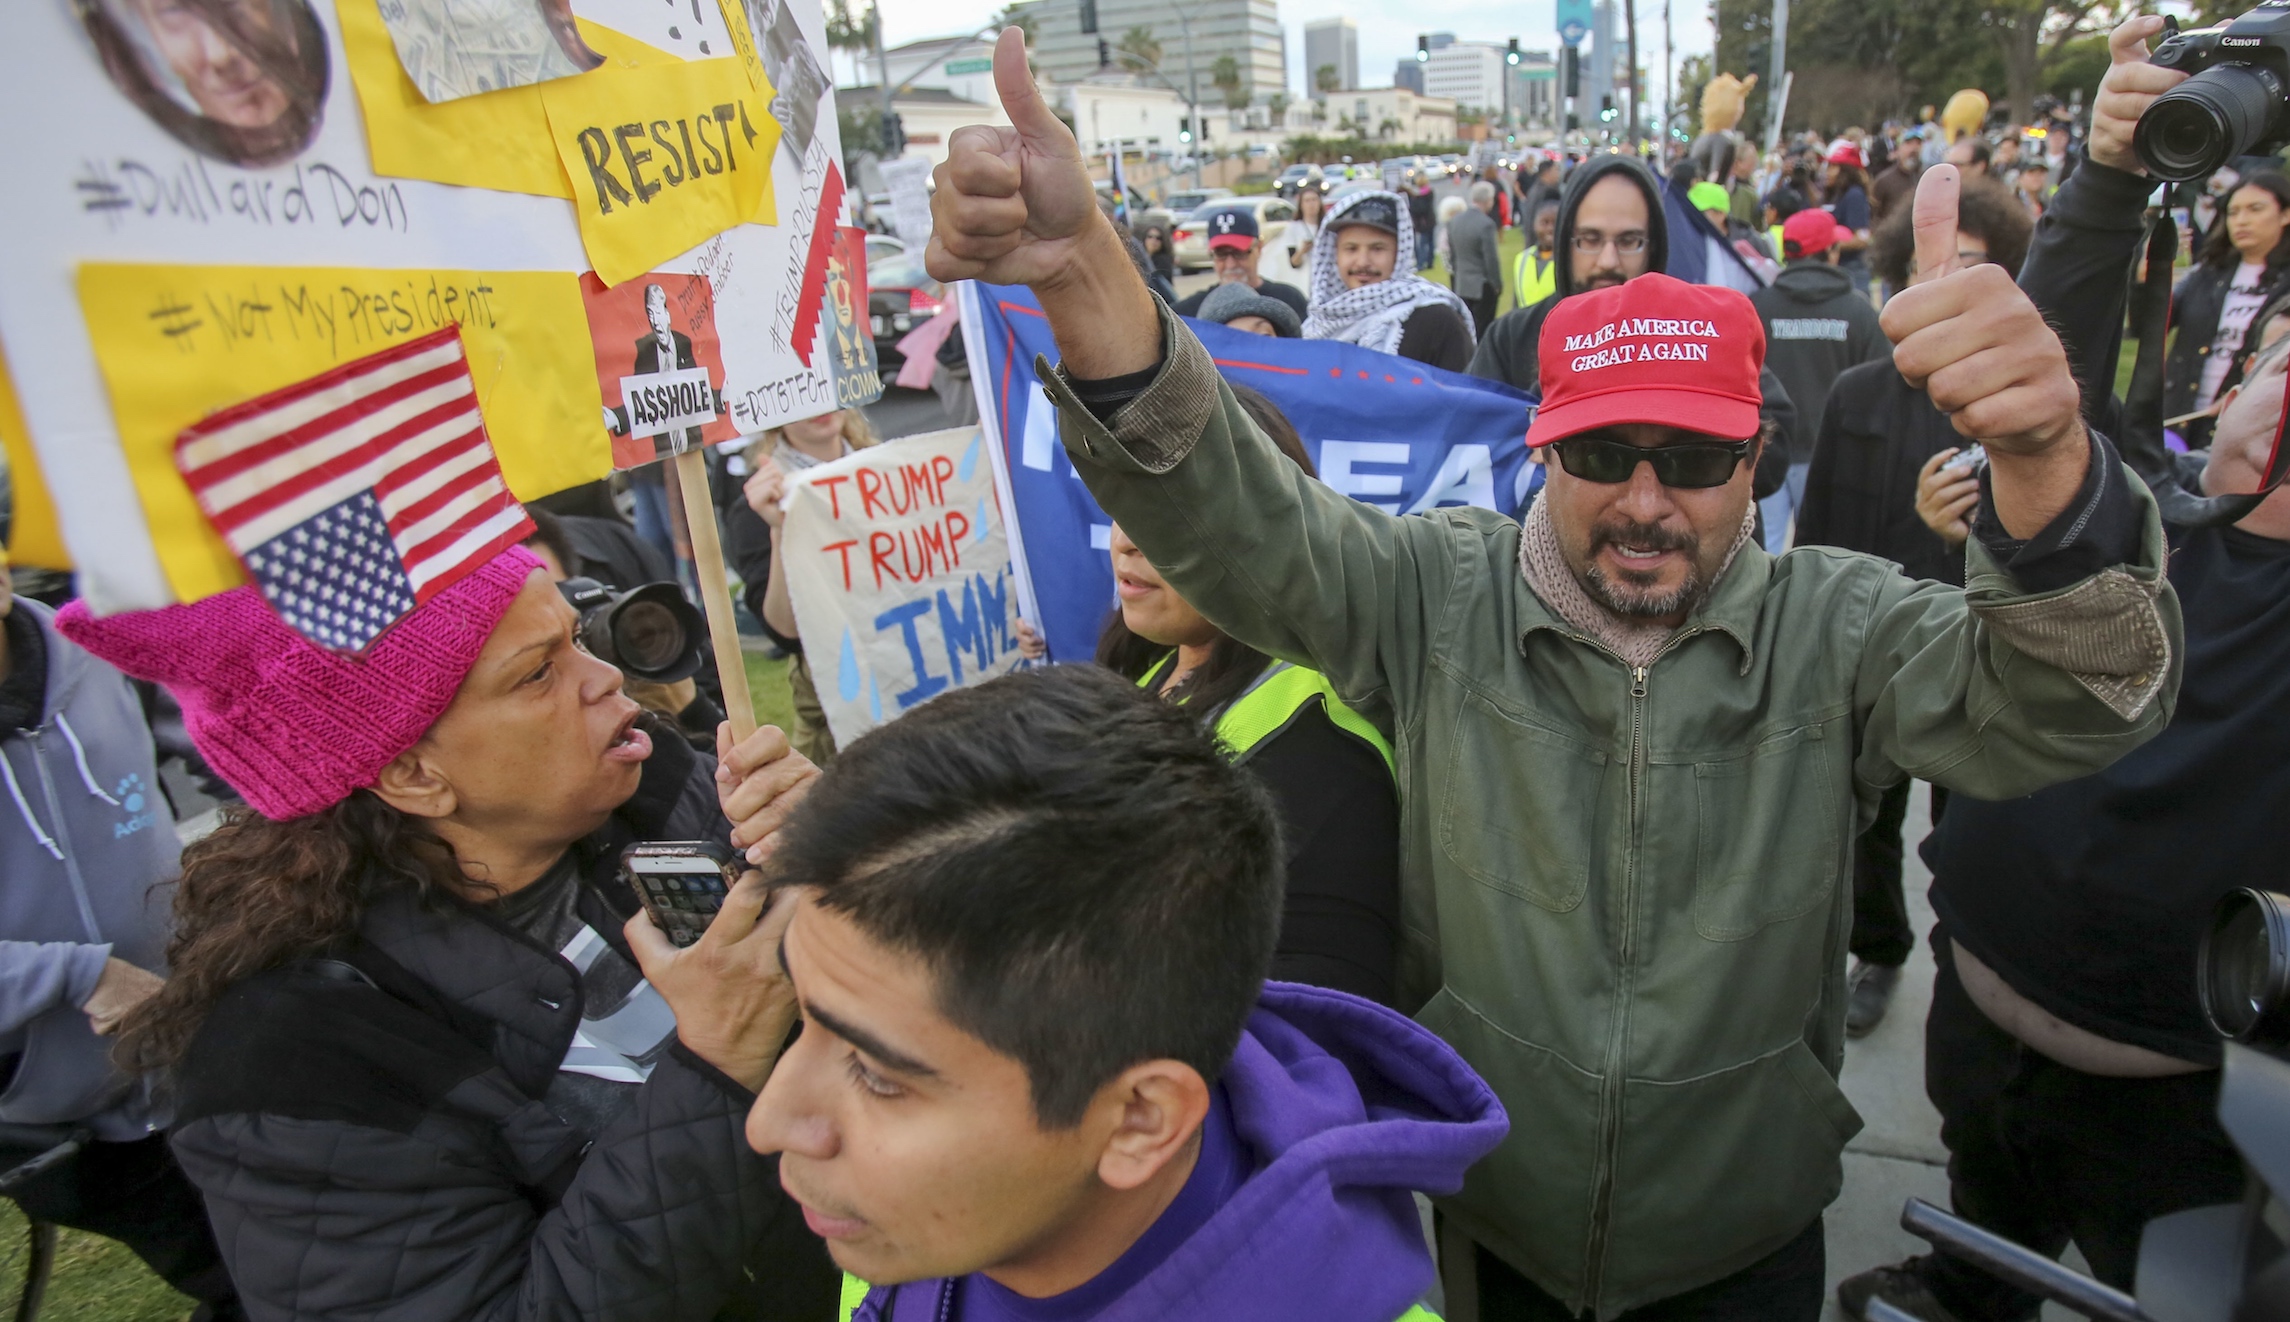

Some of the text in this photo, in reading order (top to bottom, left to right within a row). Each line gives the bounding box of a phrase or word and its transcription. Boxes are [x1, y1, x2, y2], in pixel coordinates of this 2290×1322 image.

[2221, 36, 2261, 47] Canon
[577, 103, 736, 216] RESIST
[1563, 318, 1720, 352] MAKE AMERICA
[1571, 343, 1708, 373] GREAT AGAIN
[630, 380, 710, 427] A$$HOLE
[811, 455, 953, 520] TRUMP
[1319, 439, 1538, 518] EA
[821, 511, 969, 592] TRUMP
